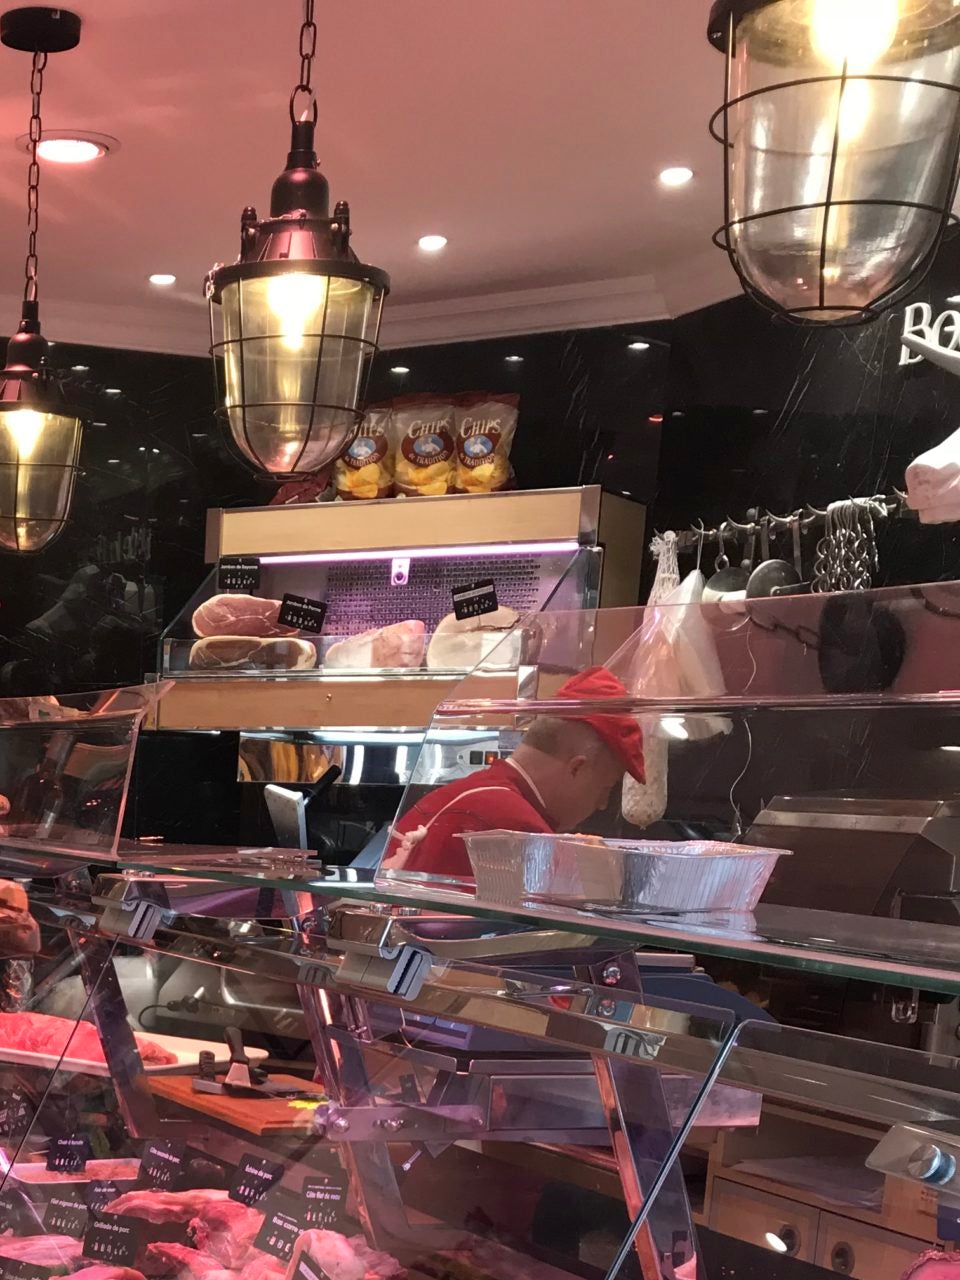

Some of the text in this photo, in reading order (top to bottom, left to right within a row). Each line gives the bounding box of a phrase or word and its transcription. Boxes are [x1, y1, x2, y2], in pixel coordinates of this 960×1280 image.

[408, 417, 451, 439] CHIPS
[460, 416, 501, 438] CHIPS
[416, 451, 448, 464] TRADITION
[464, 453, 496, 466] TRADITION
[119, 1226, 130, 1234] porc
